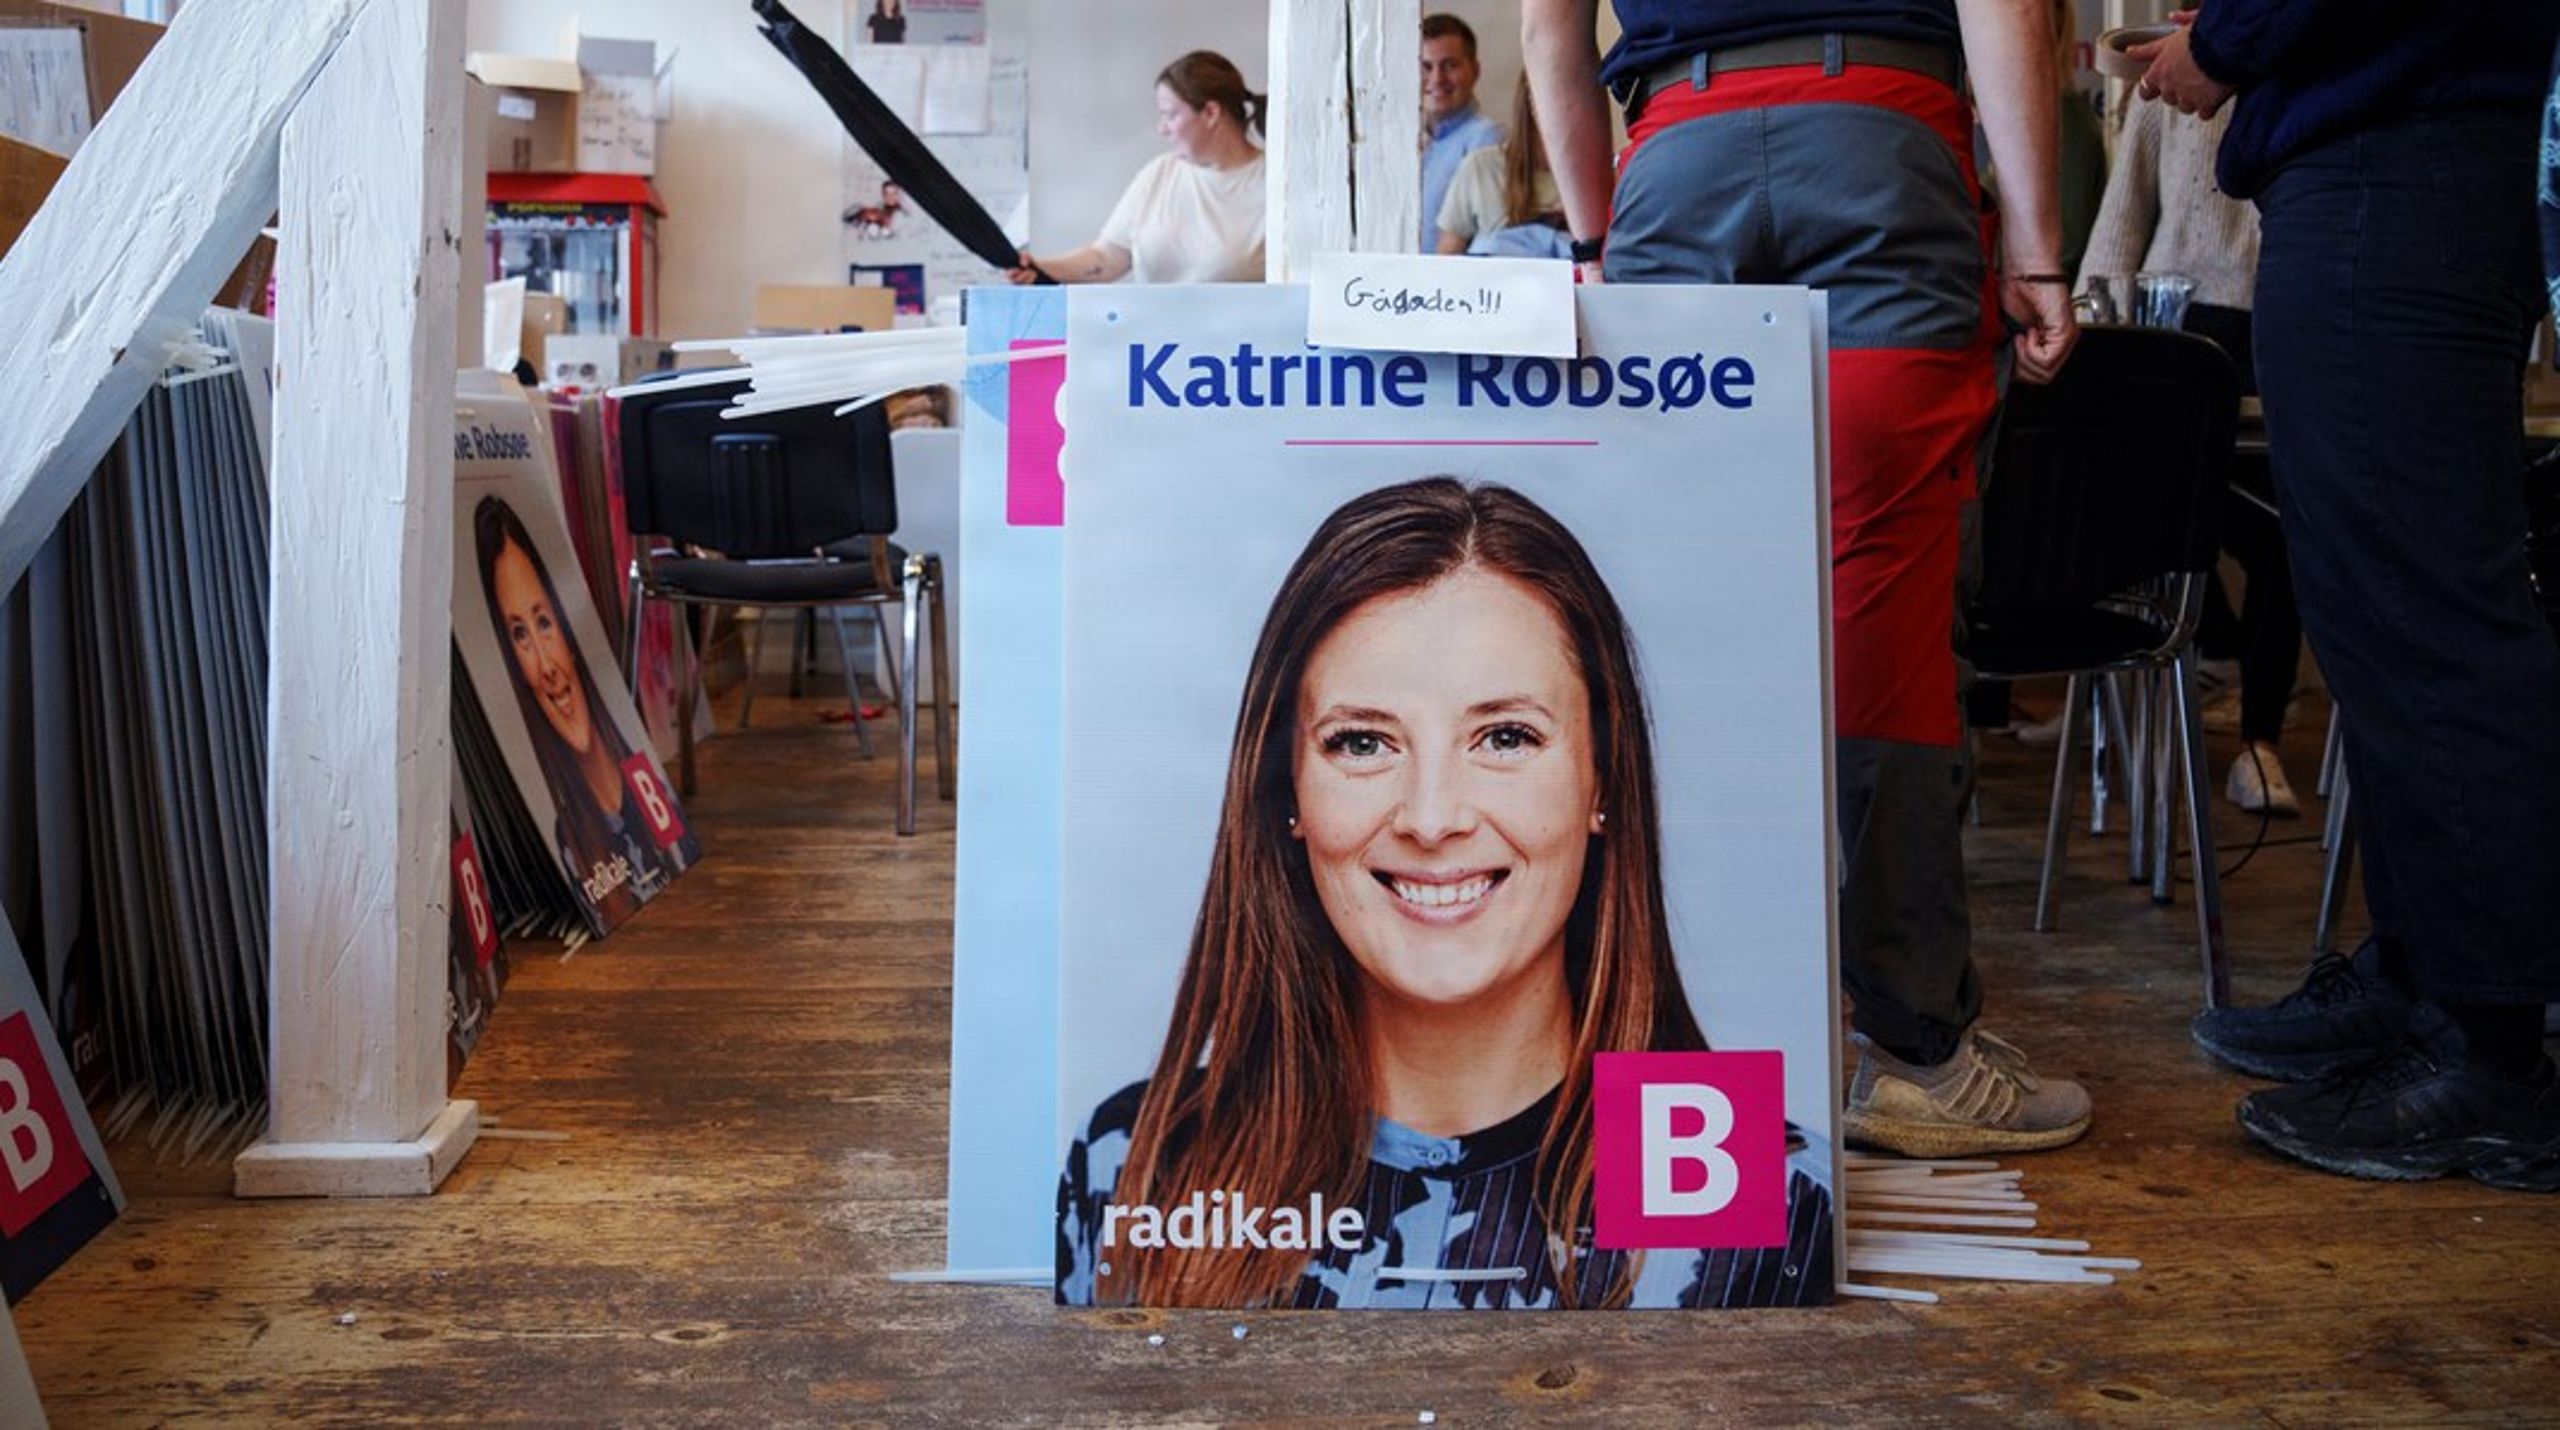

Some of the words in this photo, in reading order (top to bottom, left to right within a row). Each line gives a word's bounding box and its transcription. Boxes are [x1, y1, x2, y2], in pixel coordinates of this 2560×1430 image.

[1129, 343, 1428, 407] Katrine
[1457, 340, 1755, 413] Robsøe
[632, 769, 671, 832] B
[461, 857, 488, 946] B
[0, 1057, 54, 1194] B
[1641, 1082, 1740, 1217] B
[1103, 1189, 1366, 1250] radikale
